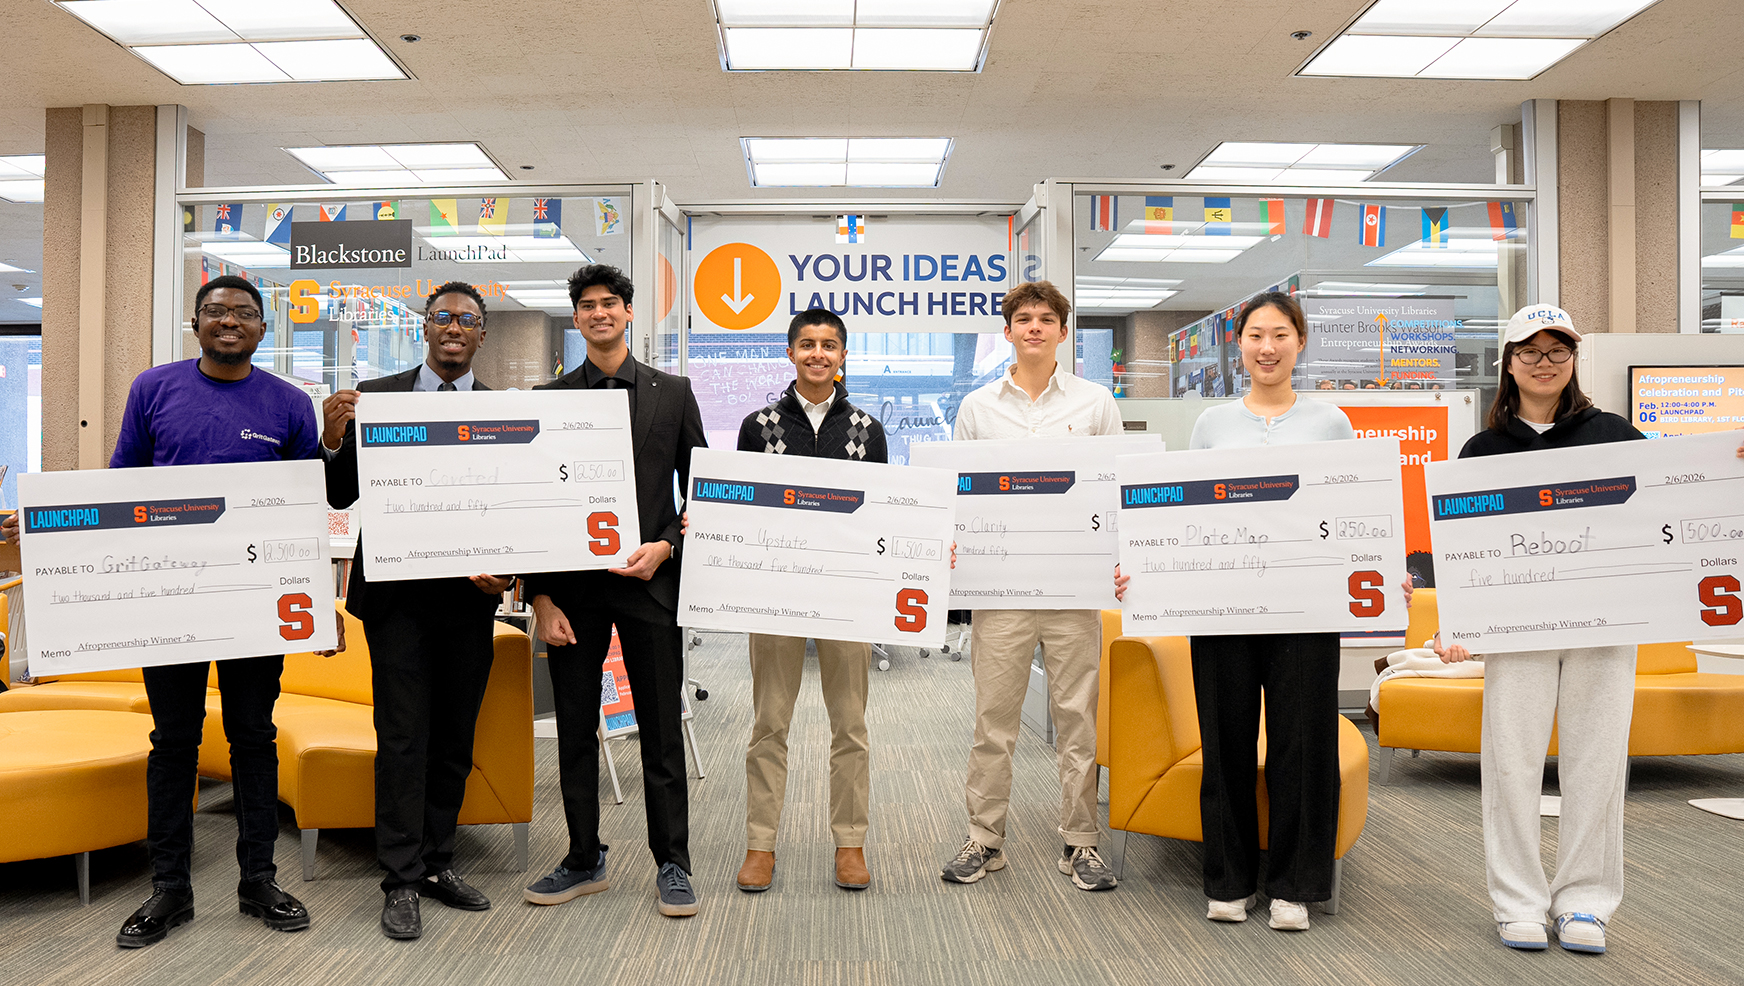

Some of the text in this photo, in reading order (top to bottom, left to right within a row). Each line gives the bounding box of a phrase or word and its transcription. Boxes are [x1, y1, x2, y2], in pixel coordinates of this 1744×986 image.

[296, 244, 406, 264] Blackstone
[418, 244, 506, 262] LaunchPad
[789, 254, 1006, 282] YOUR IDEAS
[329, 280, 412, 304] Syracuse
[789, 292, 922, 316] LAUNCH
[1319, 306, 1437, 317] Syracuse University Libraries
[329, 306, 394, 322] Libraries
[1528, 310, 1564, 320] UCLA
[1313, 322, 1354, 333] Hunter
[1358, 321, 1397, 333] Brooks
[1390, 320, 1465, 328] COMPETITIONS.
[1320, 337, 1404, 350] Entrepreneurship
[1390, 332, 1456, 340] WORKSHOPS.
[694, 347, 769, 368] ONE MAN
[1390, 346, 1460, 354] NETWORKING.
[1391, 358, 1440, 367] MENTORS.
[701, 366, 732, 381] CAN
[1391, 371, 1437, 380] FUNDING.
[1639, 374, 1725, 385] Afropreneurship
[710, 372, 795, 394] THE WORLD
[1639, 388, 1722, 397] Celebration and
[1640, 412, 1657, 422] 06
[366, 426, 427, 443] LAUNCHPAD
[472, 424, 534, 434] Syracuse University
[559, 464, 568, 482] $
[1324, 474, 1358, 483] 2/6/2026
[1665, 472, 1706, 484] 2/6/2026
[370, 479, 408, 487] PAYABLE
[1228, 481, 1293, 491] Syracuse University
[1555, 482, 1629, 496] Syracuse University
[589, 495, 616, 503] Dollars
[697, 482, 754, 501] LAUNCHPAD
[798, 490, 859, 503] Syracuse University
[1126, 486, 1183, 504] LAUNCHPAD
[251, 497, 285, 507] 2/6/2026
[386, 498, 488, 516] two hundred and fifty
[887, 496, 918, 506] 2/6/2026
[1438, 494, 1504, 516] LAUNCHPAD
[1556, 496, 1583, 504] Libraries
[150, 502, 219, 515] Syracuse University
[30, 508, 99, 528] LAUNCHPAD
[1092, 514, 1100, 531] $
[587, 511, 621, 556] S
[972, 517, 1007, 538] Clarity
[1320, 521, 1329, 540] $
[1339, 521, 1386, 538] 250.00
[1662, 524, 1673, 544] $
[695, 532, 743, 543] PAYABLE TO
[758, 528, 807, 551] Upstate
[1130, 539, 1164, 547] PAYABLE
[1510, 526, 1596, 555] Reboot
[247, 544, 257, 563] $
[877, 538, 886, 555] $
[990, 544, 1008, 561] fifty
[375, 556, 402, 564] Memo
[408, 548, 471, 558] Afropreneurship
[1352, 553, 1382, 562] Dollars
[1445, 549, 1501, 561] PAYABLE TO
[1701, 556, 1737, 567] Dollars
[36, 564, 94, 576] PAYABLE TO
[708, 555, 823, 574] one thousand five hundred
[1143, 555, 1267, 577] two hundred and fifty
[280, 576, 310, 586] Dollars
[902, 572, 930, 582] Dollars
[1470, 567, 1555, 587] five hundred
[52, 584, 195, 603] two thousand and five hundred
[1348, 570, 1385, 617] S
[1698, 575, 1743, 626] S
[277, 593, 314, 641] S
[689, 605, 713, 613] Memo
[720, 603, 780, 616] Afropreneurship
[781, 608, 808, 617] Winner
[894, 588, 928, 632] S
[1163, 608, 1224, 617] Afropreneurship
[1453, 631, 1480, 639] Memo
[1487, 622, 1557, 634] Afropreneurship
[1559, 618, 1592, 628] Winner
[41, 649, 71, 659] Memo
[78, 639, 148, 652] Afropreneurship
[151, 636, 181, 644] Winner
